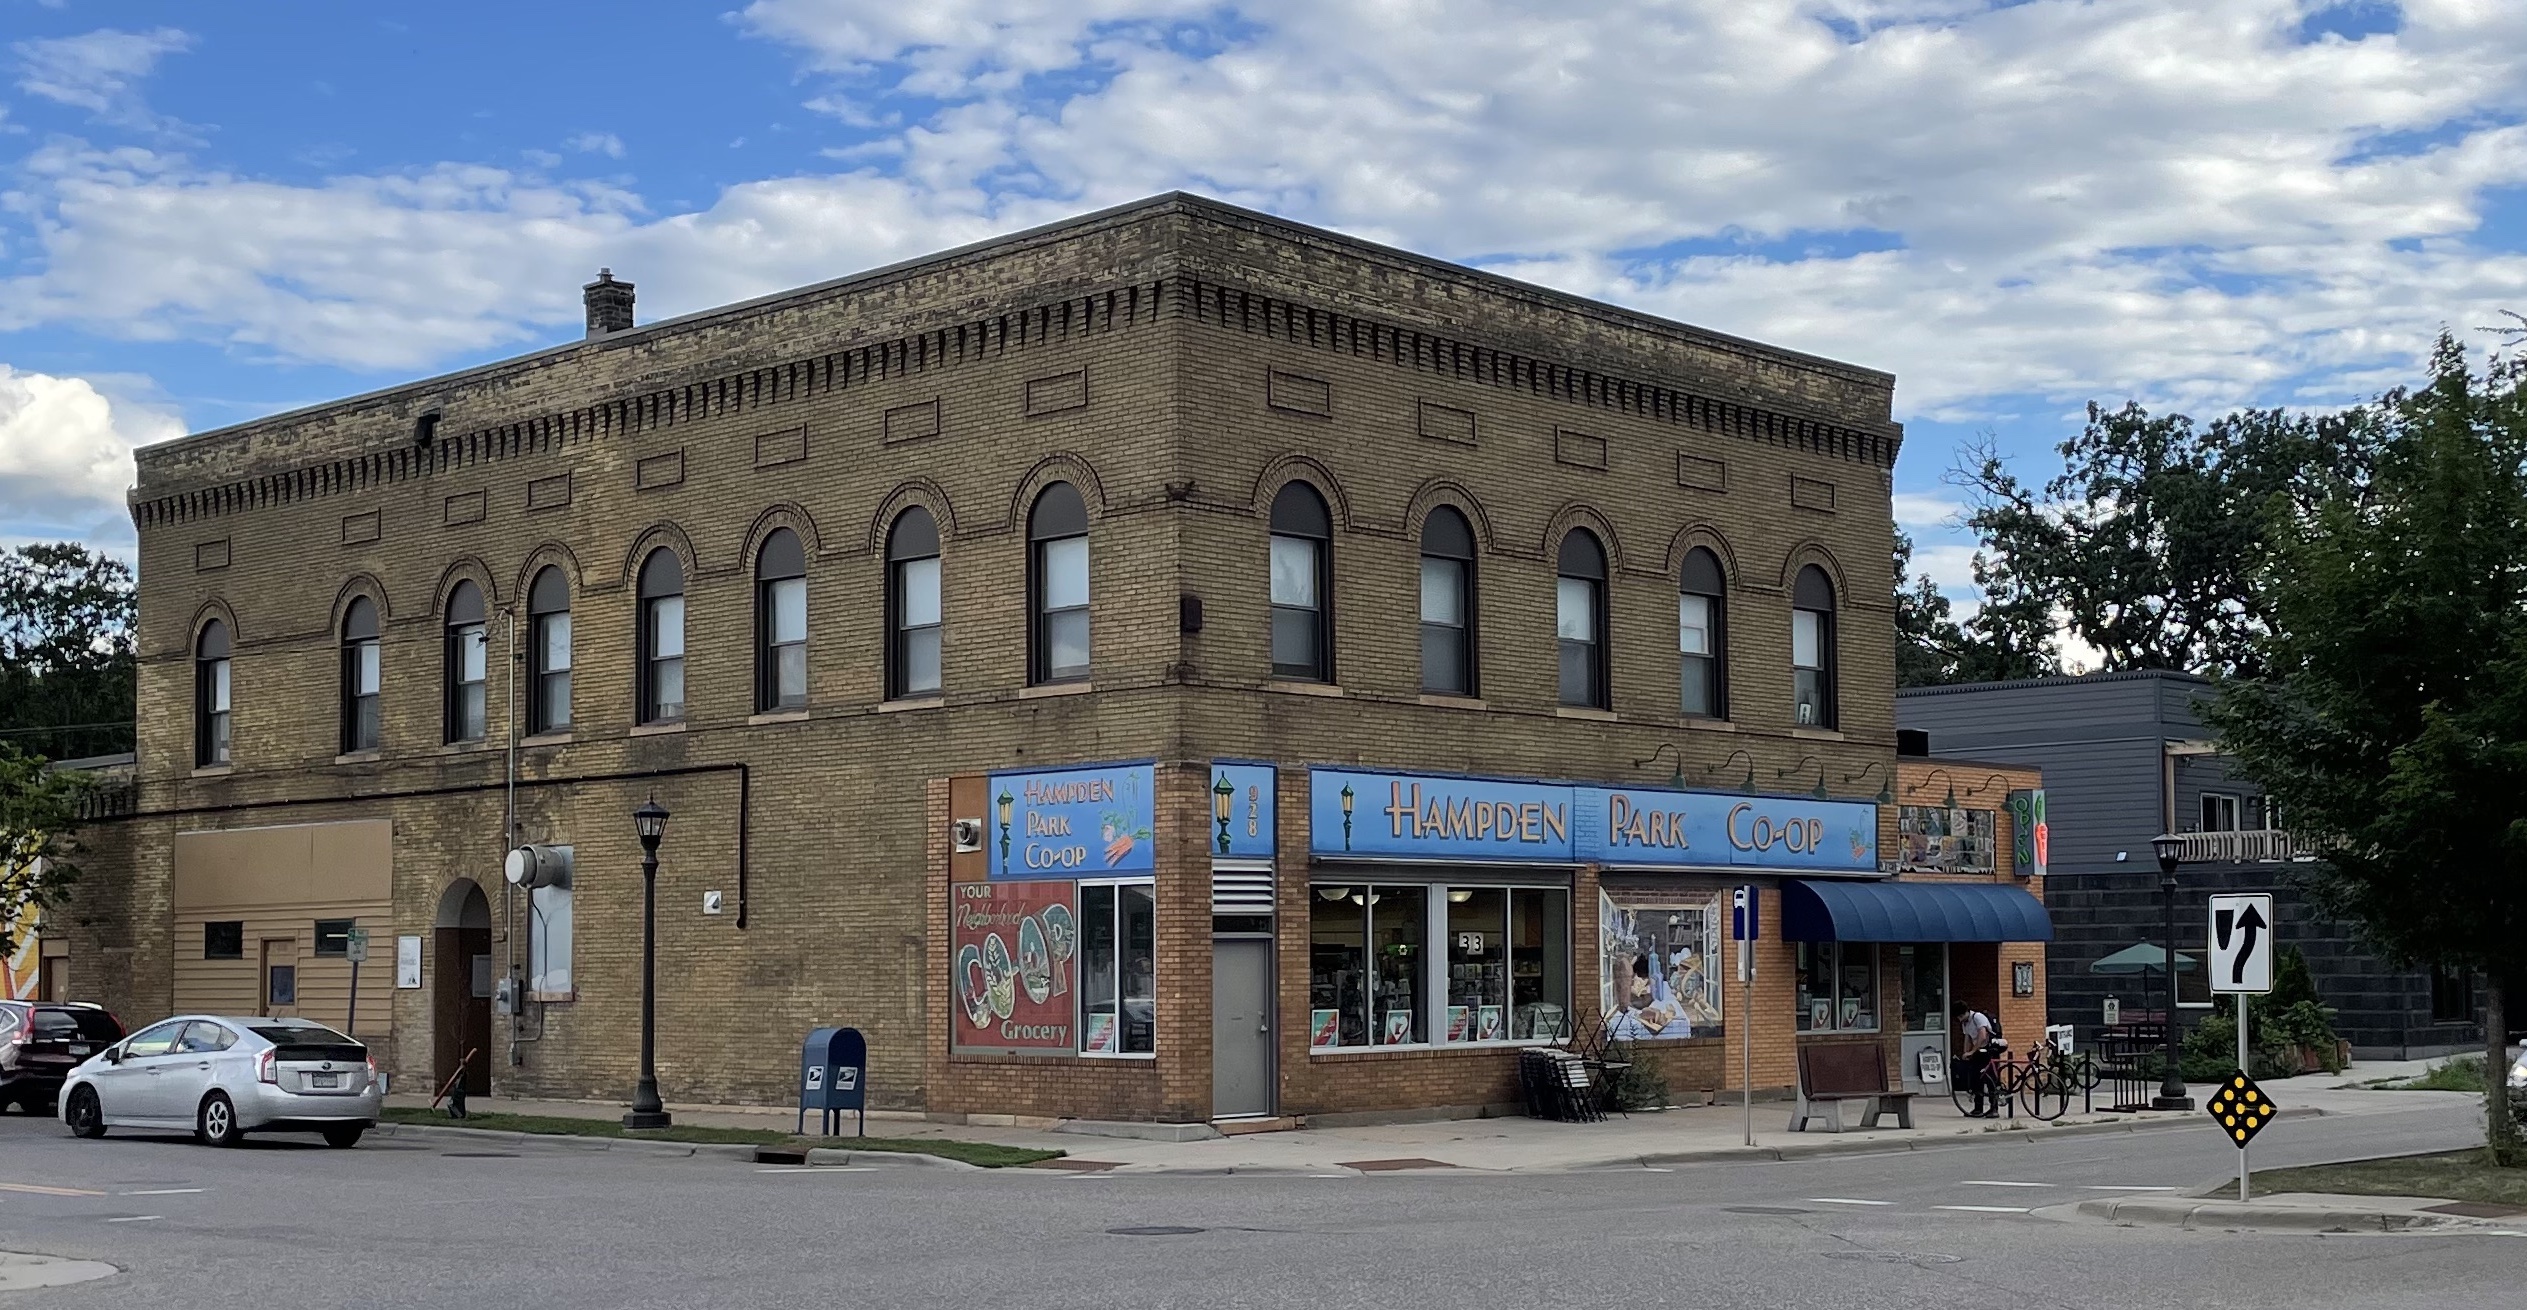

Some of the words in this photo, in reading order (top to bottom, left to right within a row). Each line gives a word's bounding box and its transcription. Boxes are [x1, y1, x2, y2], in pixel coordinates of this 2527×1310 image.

[1024, 778, 1114, 806] HAMPDEN
[1025, 810, 1072, 838] PARK
[1248, 785, 1258, 837] 928
[1384, 781, 1566, 844] HAMPDEN
[1609, 794, 1689, 849] PARK
[1727, 802, 1823, 854] CO-OP
[1024, 842, 1087, 870] CO-OP
[959, 885, 992, 899] YOUR
[1462, 935, 1481, 951] 33
[1001, 1019, 1068, 1047] Grocery
